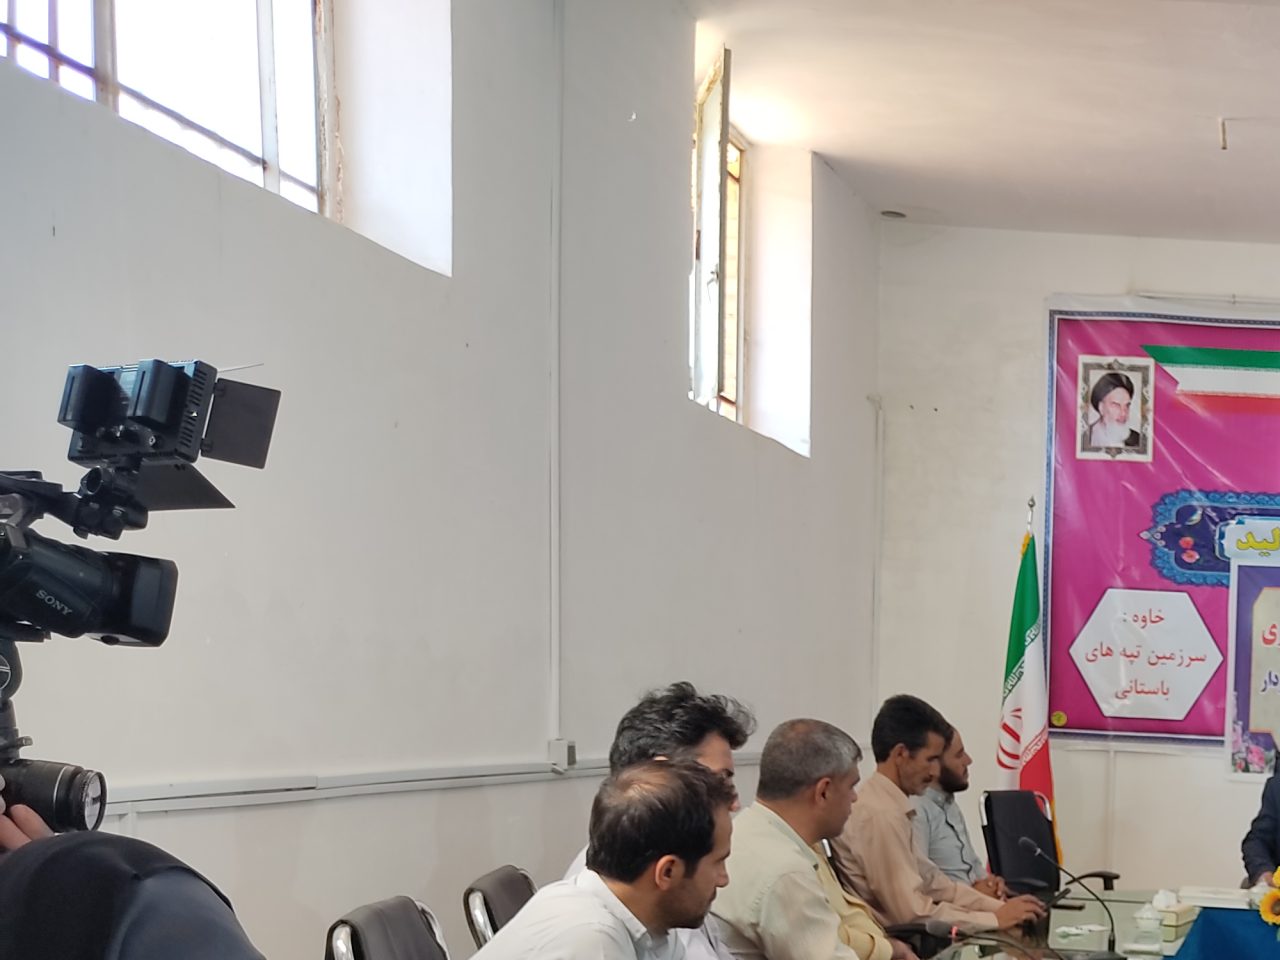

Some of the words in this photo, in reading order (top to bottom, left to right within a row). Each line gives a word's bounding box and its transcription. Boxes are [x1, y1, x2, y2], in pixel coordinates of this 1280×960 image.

[36, 589, 73, 616] SONY
[1131, 608, 1165, 629] خاوه
[1085, 641, 1114, 663] های
[1119, 645, 1142, 665] تپه
[1147, 649, 1207, 668] سرزمین
[1115, 678, 1170, 701] باستانی
